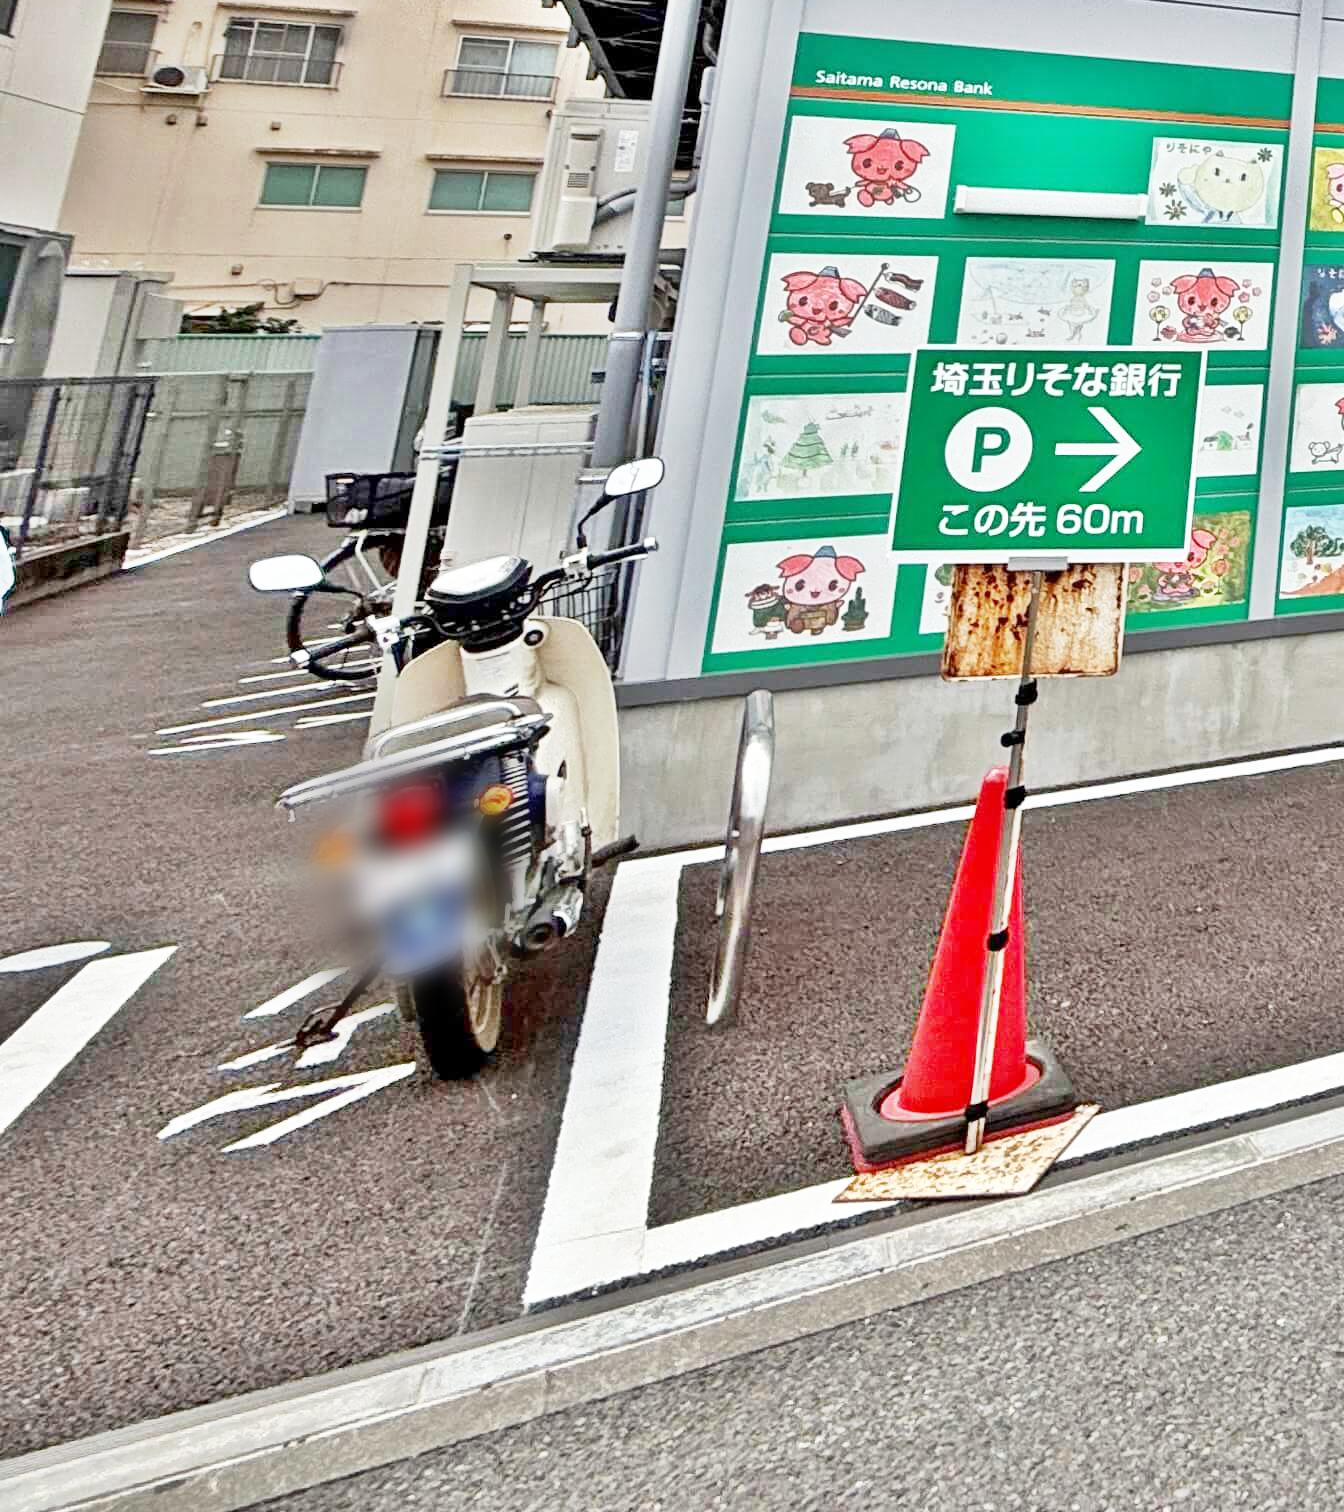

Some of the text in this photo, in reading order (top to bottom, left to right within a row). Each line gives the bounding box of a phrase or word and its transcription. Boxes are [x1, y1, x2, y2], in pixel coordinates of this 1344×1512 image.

[815, 69, 993, 96] Saitama Resona Bank
[930, 361, 1182, 398] 埼玉りそな銀行
[972, 425, 1012, 474] P
[937, 502, 1144, 538] この先 60m
